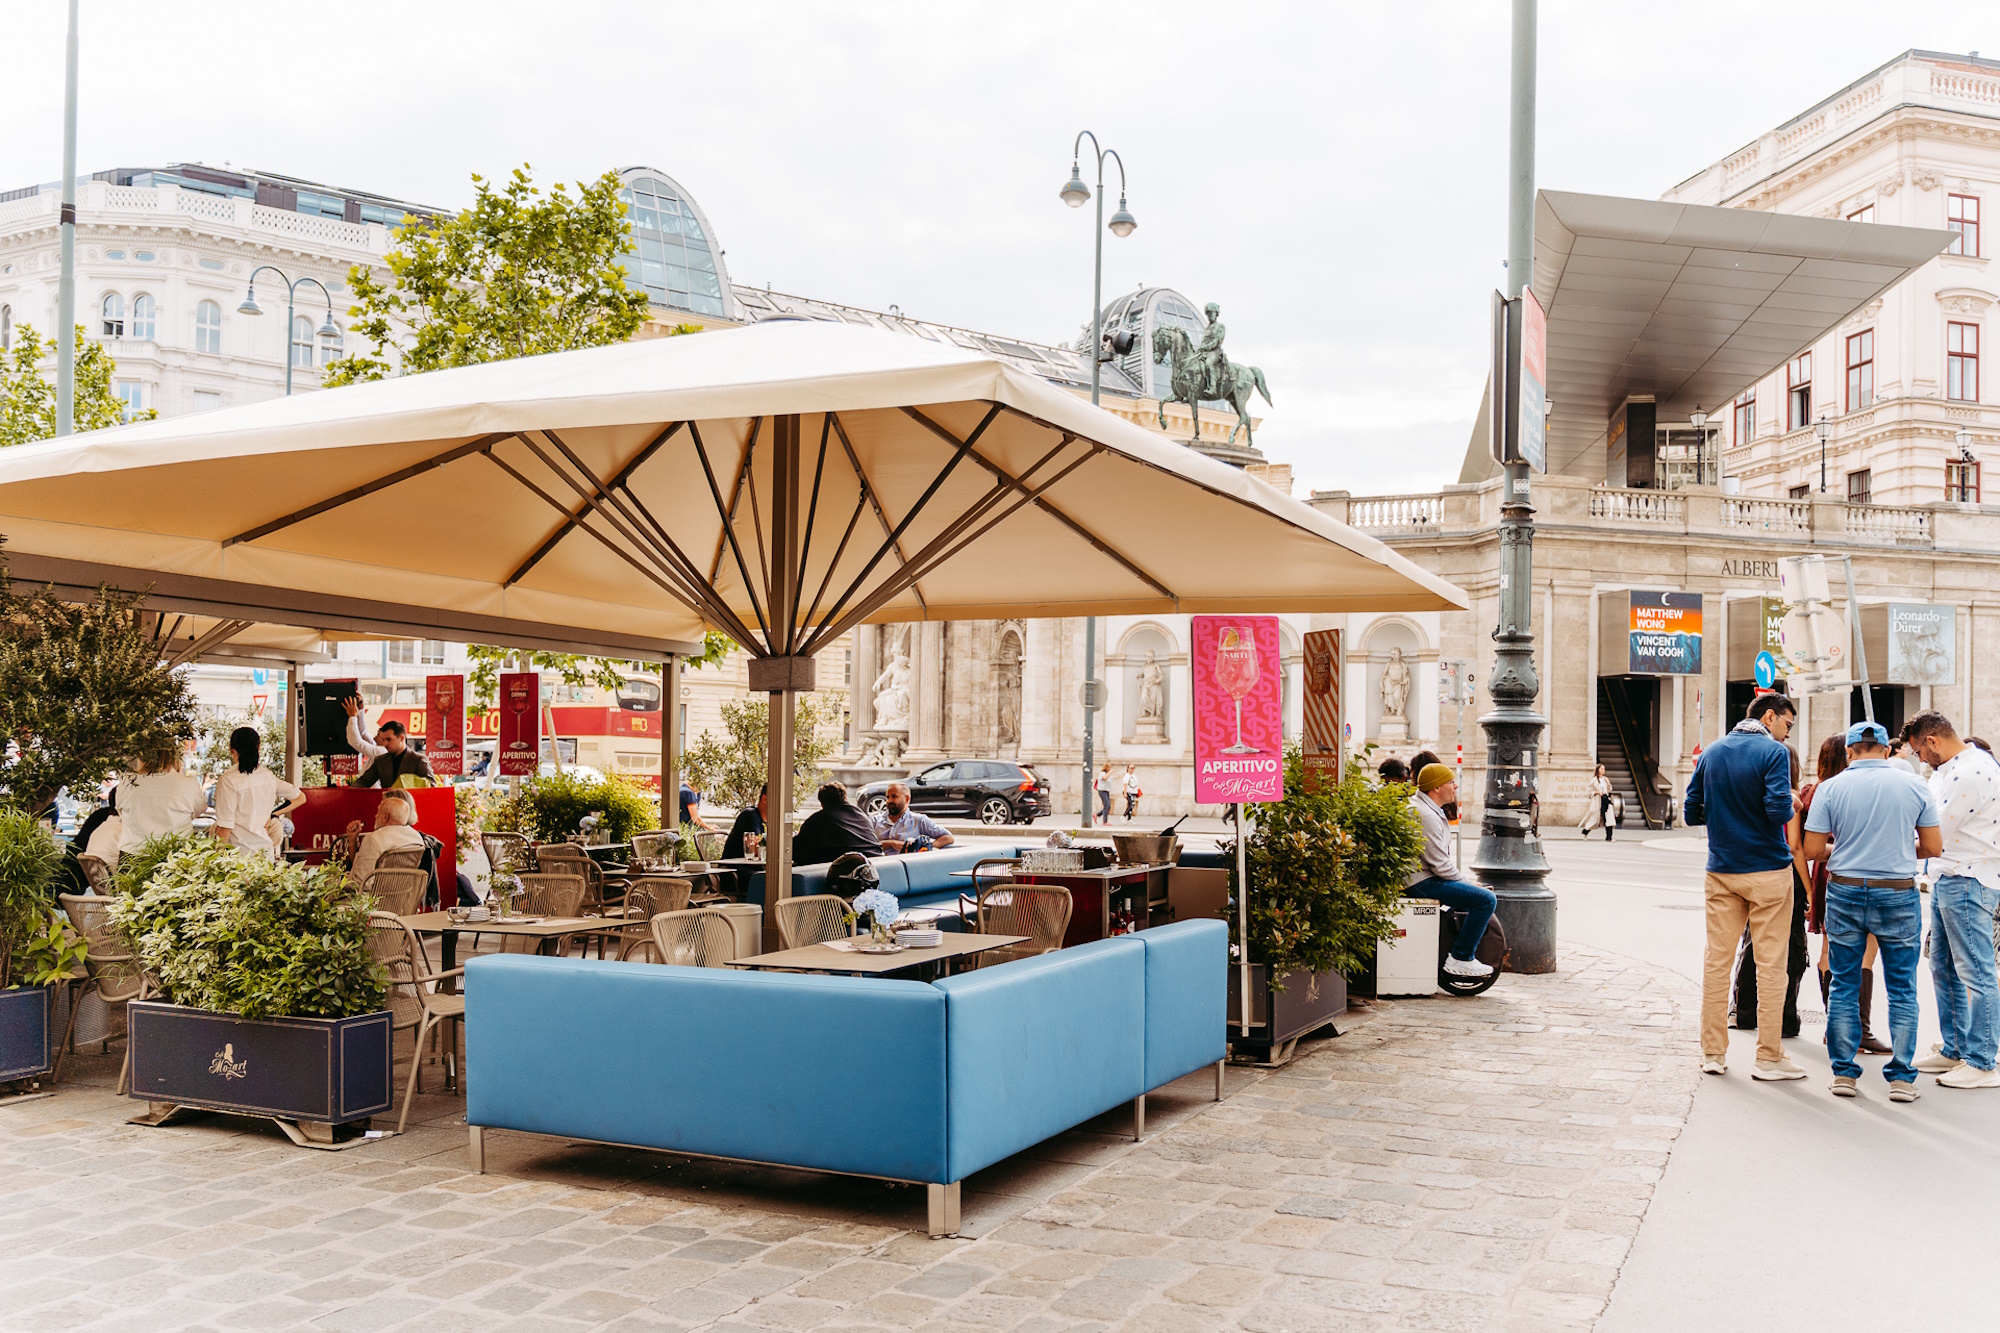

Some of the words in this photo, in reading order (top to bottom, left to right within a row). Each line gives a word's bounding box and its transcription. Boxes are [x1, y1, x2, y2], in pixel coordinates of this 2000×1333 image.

[1721, 559, 1779, 578] ALBERT
[1636, 608, 1683, 619] MATTHEW
[1893, 608, 1940, 622] Leonardo
[1636, 618, 1665, 629] WONG
[1893, 621, 1922, 633] Dürer
[1637, 635, 1677, 646] VINCENT
[1636, 646, 1656, 656] VAN
[1658, 647, 1684, 657] GOGH
[428, 751, 461, 759] APERITIVO
[502, 751, 537, 759] APERITIVO
[1202, 759, 1277, 774] APERITIVO
[1203, 776, 1216, 784] im
[1221, 775, 1276, 801] Mozart
[1414, 907, 1436, 915] MROK
[208, 1059, 248, 1081] Mozart
